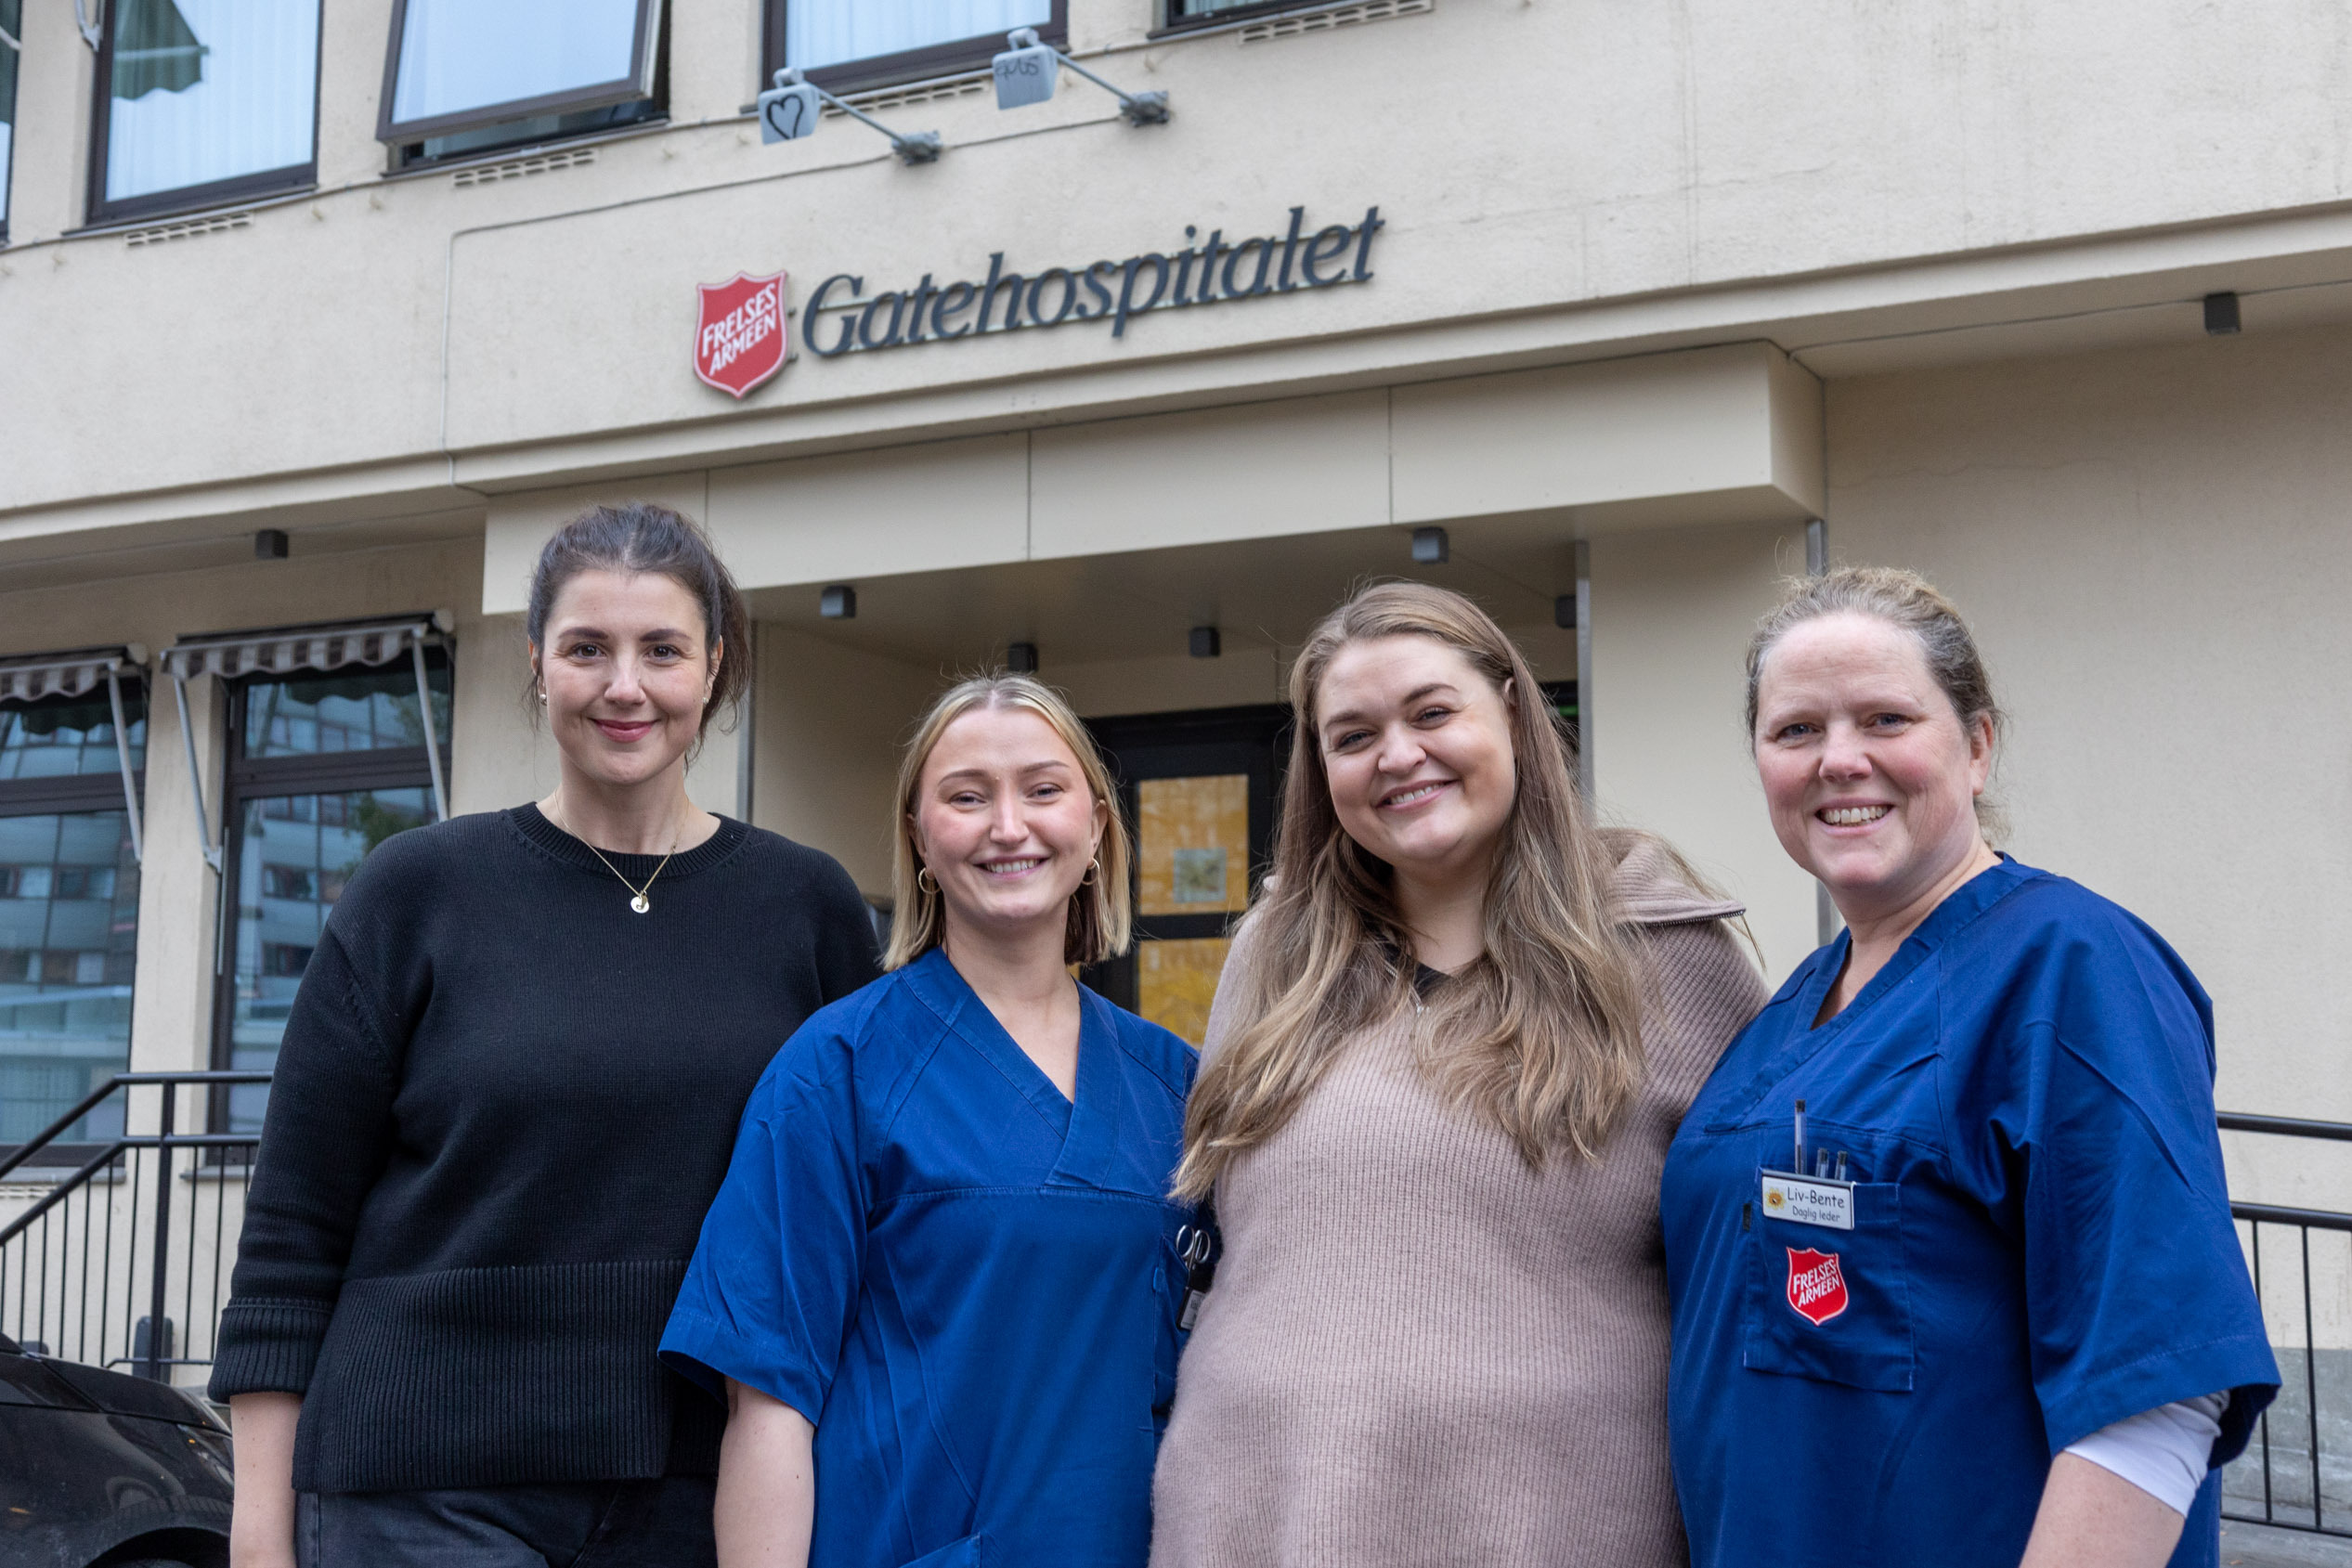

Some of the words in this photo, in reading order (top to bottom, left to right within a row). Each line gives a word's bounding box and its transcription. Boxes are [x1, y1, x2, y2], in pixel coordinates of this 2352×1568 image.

[801, 206, 1385, 357] Gatehospitalet
[701, 282, 776, 358] FRELSES
[708, 307, 776, 376] ARMEEN
[1787, 1186, 1845, 1209] Liv-Bente
[1792, 1205, 1817, 1222] Daglig
[1819, 1209, 1840, 1222] leder
[1798, 1274, 1839, 1308] ARMEEN
